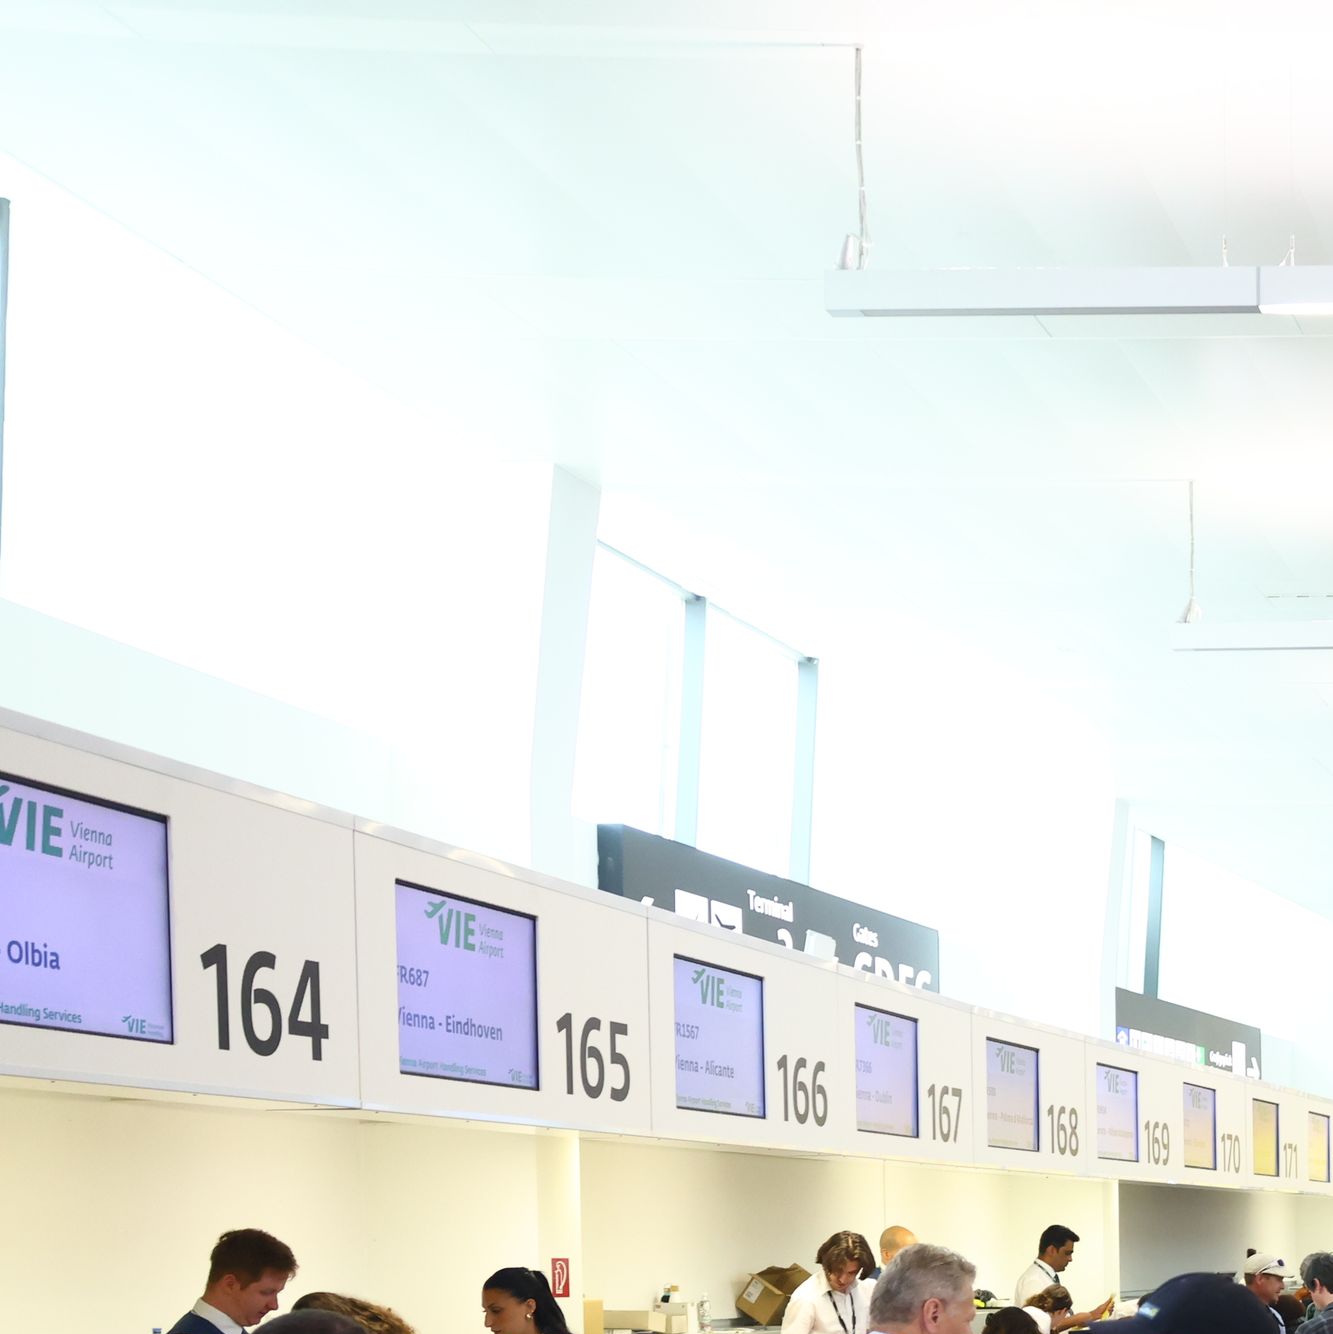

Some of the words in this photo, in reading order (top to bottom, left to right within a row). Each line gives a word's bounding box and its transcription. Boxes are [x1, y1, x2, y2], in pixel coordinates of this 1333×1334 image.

[70, 820, 113, 847] Vienna
[68, 844, 114, 870] Airport
[747, 889, 794, 924] Terminal
[438, 907, 476, 952] VIE
[478, 923, 504, 941] Vienna
[853, 923, 879, 948] Gates
[7, 939, 61, 971] Olbia
[478, 940, 504, 959] Airport
[199, 943, 330, 1062] 164
[700, 974, 725, 1009] VIE
[43, 1007, 83, 1025] Services
[128, 1017, 147, 1035] VIE
[445, 1014, 503, 1042] Eindhoven
[873, 1019, 890, 1048] VIE
[555, 1012, 631, 1103] 165
[705, 1060, 735, 1079] Alicante
[1000, 1051, 1016, 1074] VIE
[776, 1053, 829, 1128] 166
[927, 1083, 962, 1144] 167
[1047, 1104, 1079, 1157] 168
[1144, 1119, 1171, 1167] 169
[1220, 1132, 1242, 1174] 170
[1283, 1142, 1299, 1180] 171
